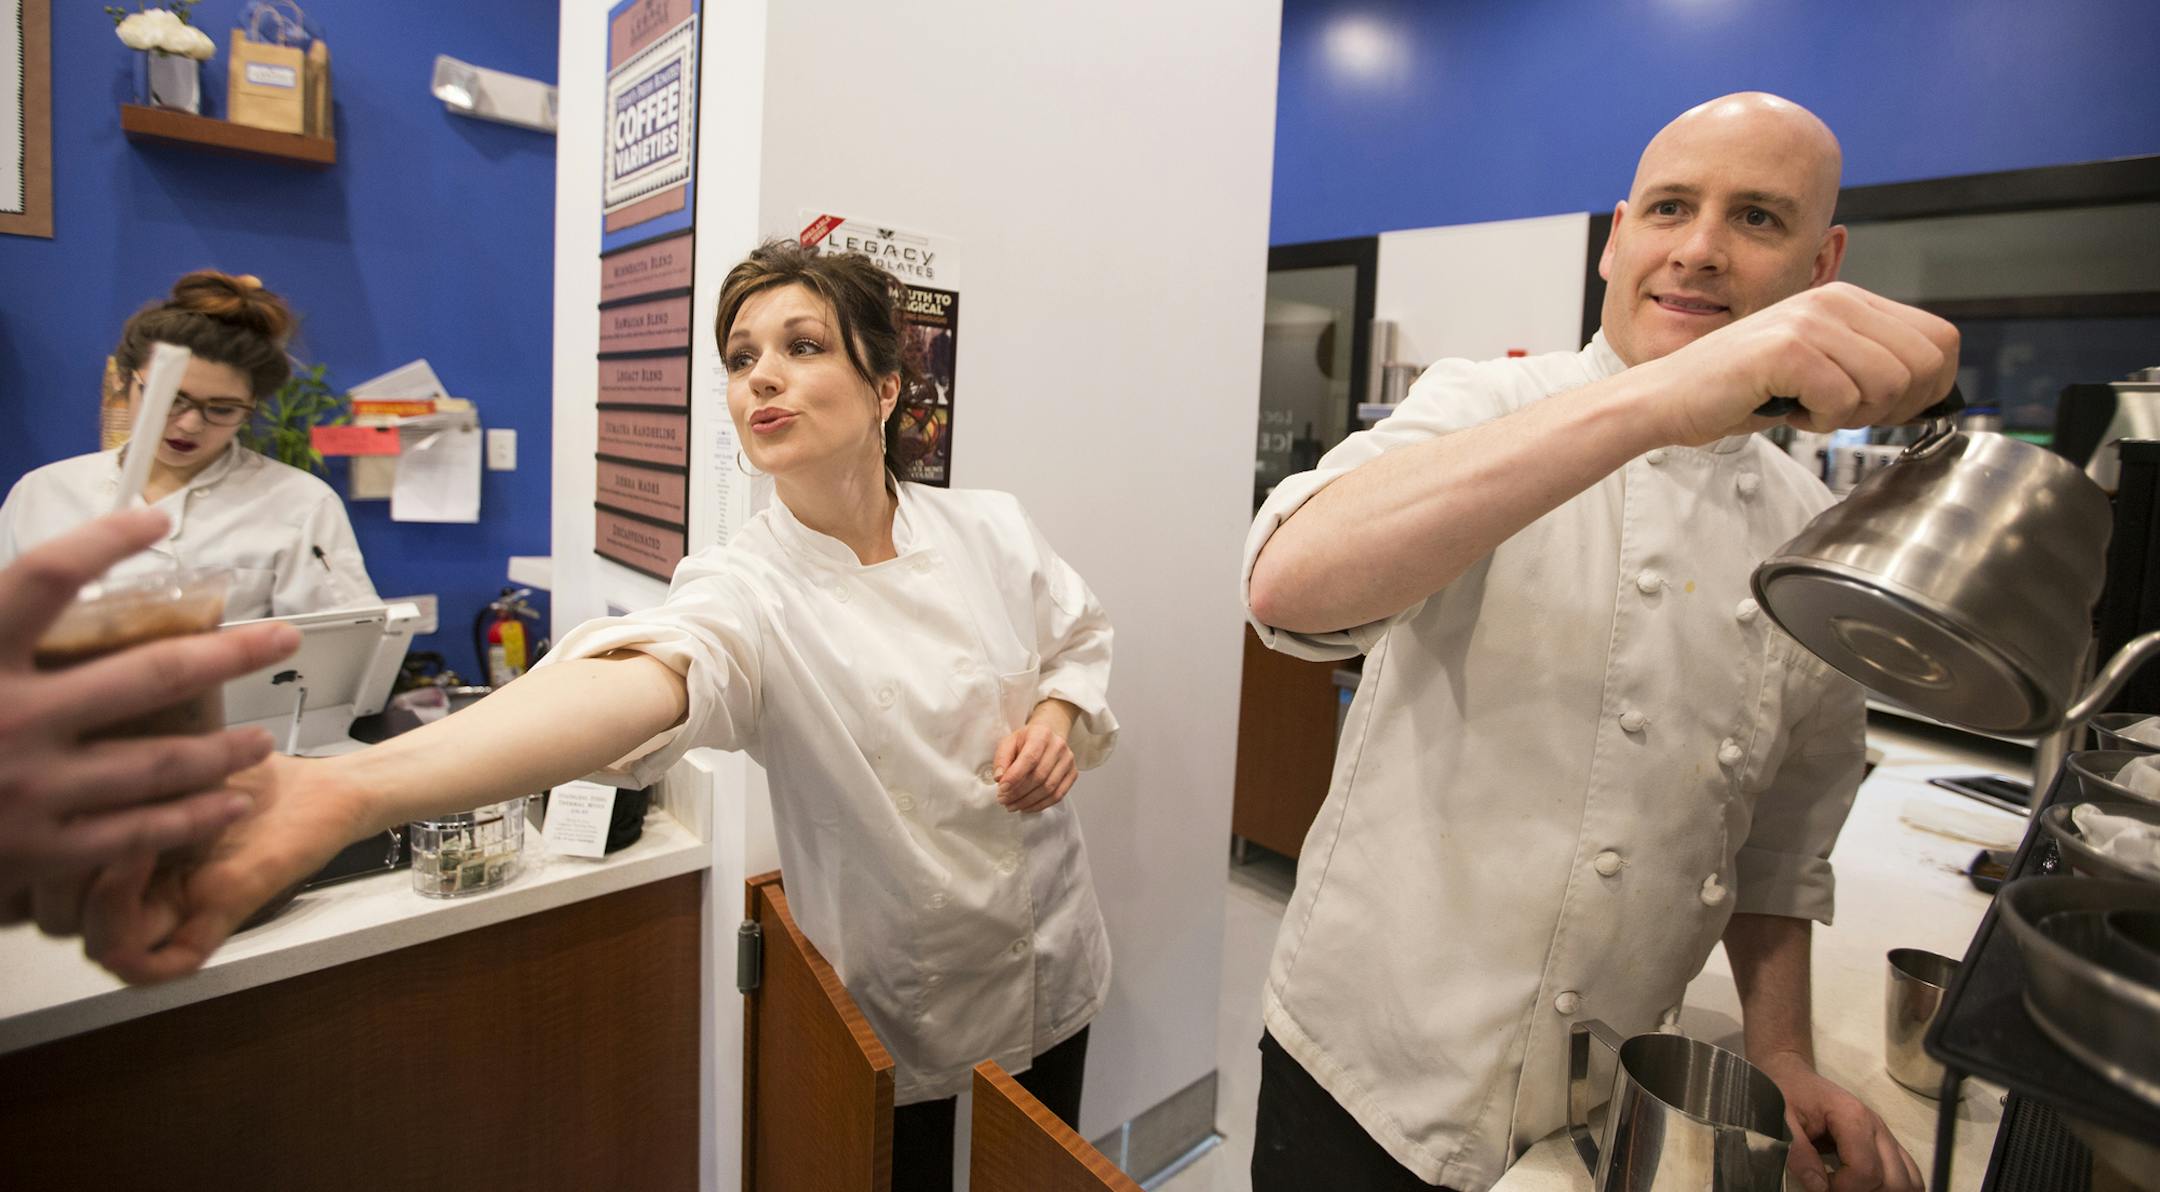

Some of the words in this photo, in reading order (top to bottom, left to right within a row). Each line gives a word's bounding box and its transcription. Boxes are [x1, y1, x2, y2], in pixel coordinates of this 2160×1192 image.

[615, 80, 680, 150] COFFEE
[615, 124, 679, 177] VARIETIES
[828, 233, 934, 266] LEGACY
[650, 254, 673, 269] BLEND
[888, 286, 932, 303] MUTH
[934, 293, 951, 306] TO
[646, 312, 668, 327] BLEND
[641, 367, 663, 382] BLEND
